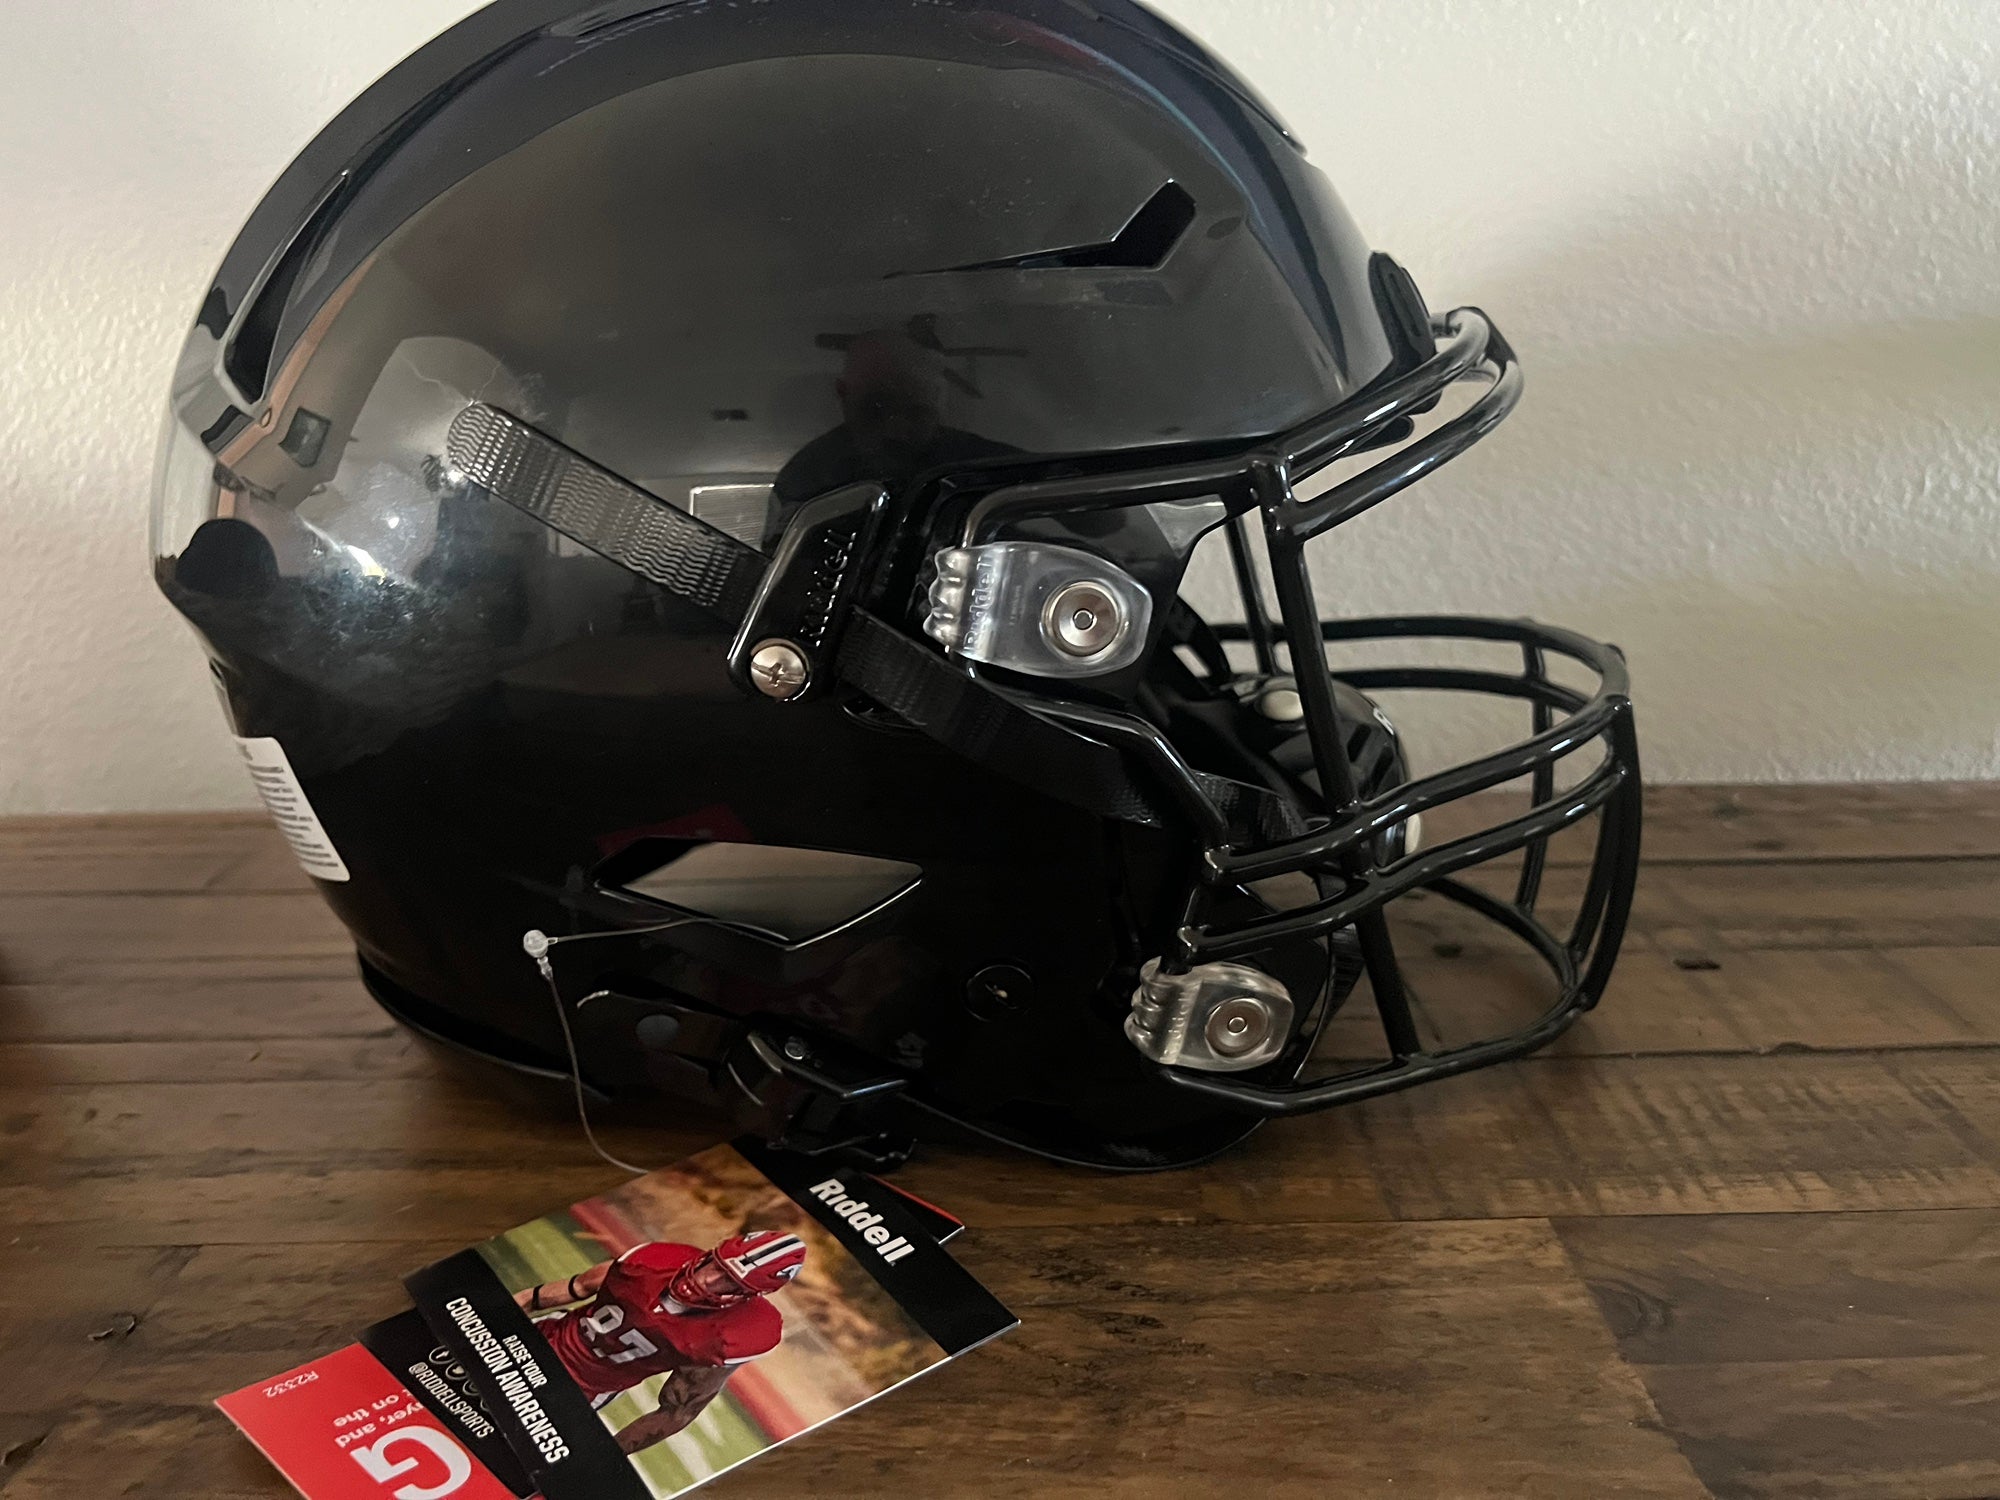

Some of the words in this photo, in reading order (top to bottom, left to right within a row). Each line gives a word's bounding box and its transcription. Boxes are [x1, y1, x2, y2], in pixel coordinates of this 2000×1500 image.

[808, 1178, 915, 1264] Riddell
[445, 1297, 513, 1374] CONCUSSION
[495, 1369, 570, 1464] AWARENESS
[502, 1334, 532, 1364] RAISE
[520, 1358, 548, 1388] YOUR
[333, 1408, 370, 1427] the
[371, 1394, 399, 1411] on
[408, 1361, 495, 1439] @RIDDELLSPORTS
[334, 1422, 377, 1448] and
